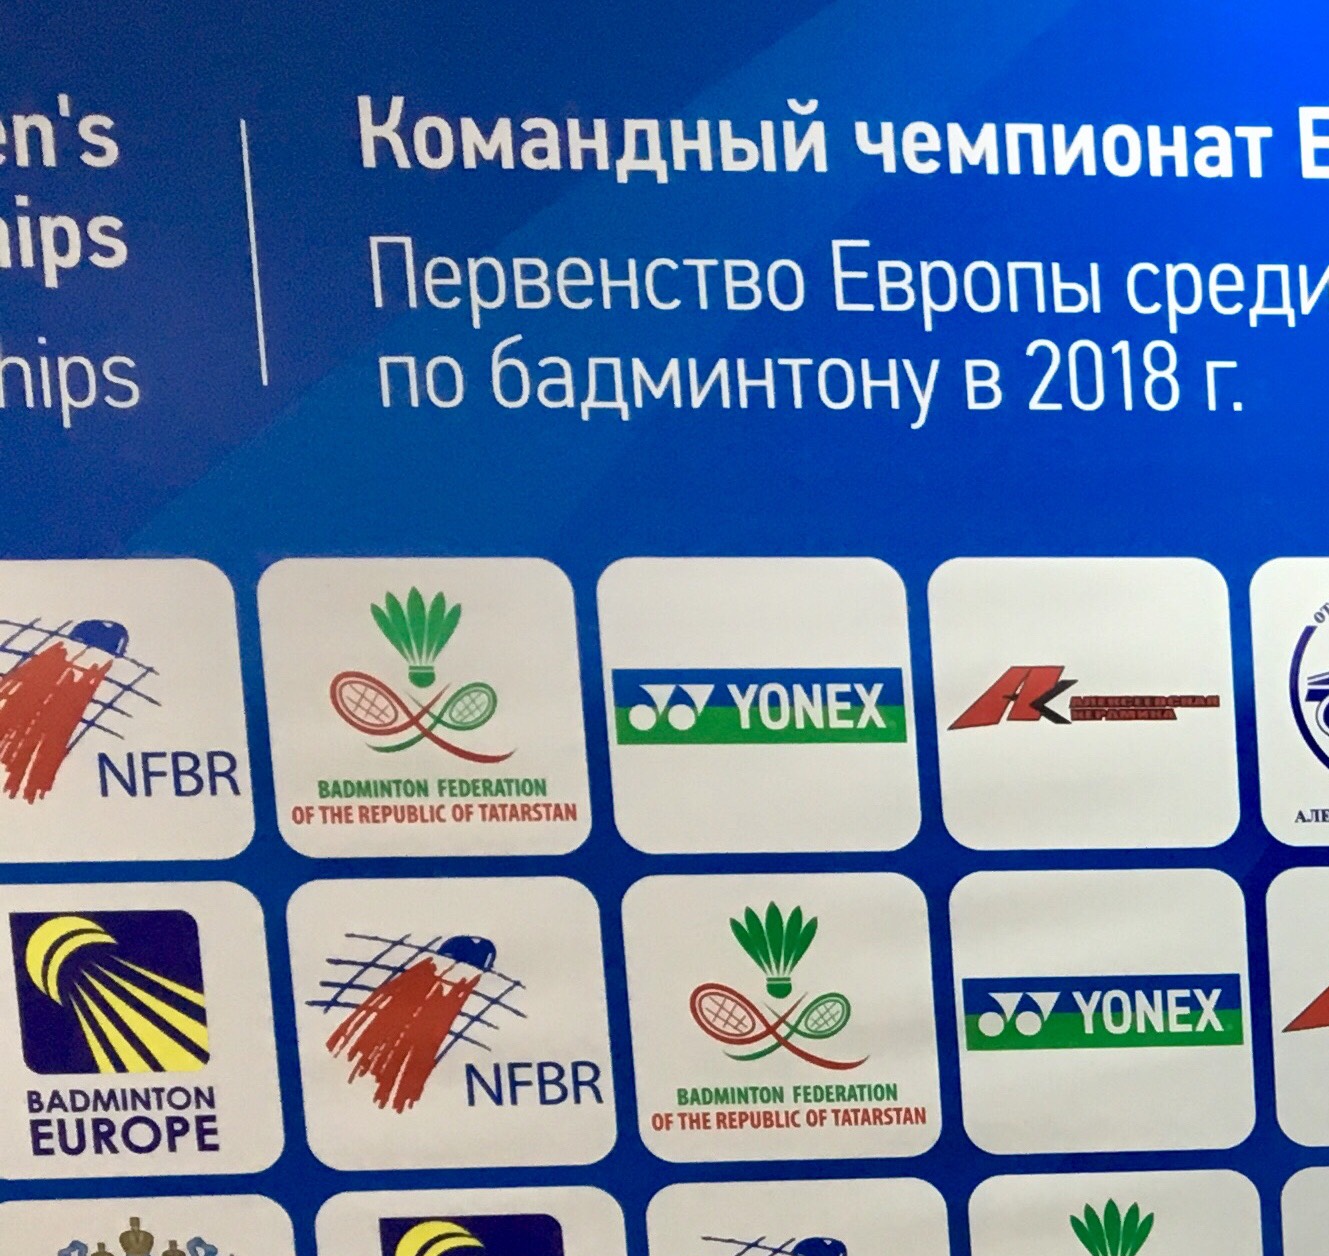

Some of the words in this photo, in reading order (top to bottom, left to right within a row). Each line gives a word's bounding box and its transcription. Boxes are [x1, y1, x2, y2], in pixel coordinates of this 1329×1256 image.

[0, 92, 119, 168] n's
[358, 95, 827, 183] Командный
[855, 121, 1272, 178] чемпионат
[370, 236, 804, 328] Первенство
[832, 240, 1100, 331] Европы
[379, 356, 463, 408] по
[492, 335, 939, 429] бадминтону
[965, 360, 1002, 409] в
[1026, 339, 1179, 411] 2018
[1206, 361, 1242, 411] г.
[727, 683, 888, 731] YONEX
[97, 750, 241, 797] NFBR
[317, 777, 429, 799] BADMINTON
[438, 776, 548, 798] FEDERATION
[292, 804, 313, 825] OF
[316, 804, 355, 824] THE
[358, 803, 447, 824] REPUBLIC
[452, 803, 474, 823] OF
[479, 802, 578, 823] TATARSTAN
[1071, 987, 1224, 1035] YONEX
[26, 1086, 216, 1113] BADMINTON
[464, 1060, 604, 1107] NFBR
[676, 1085, 785, 1106] BADMINTON
[792, 1082, 898, 1103] FEDERATION
[29, 1115, 220, 1156] EUROPE
[650, 1112, 674, 1131] OF
[677, 1111, 712, 1131] THE
[715, 1109, 801, 1130] REPUBLIC
[805, 1108, 828, 1128] OF
[831, 1106, 927, 1127] TATARSTAN
